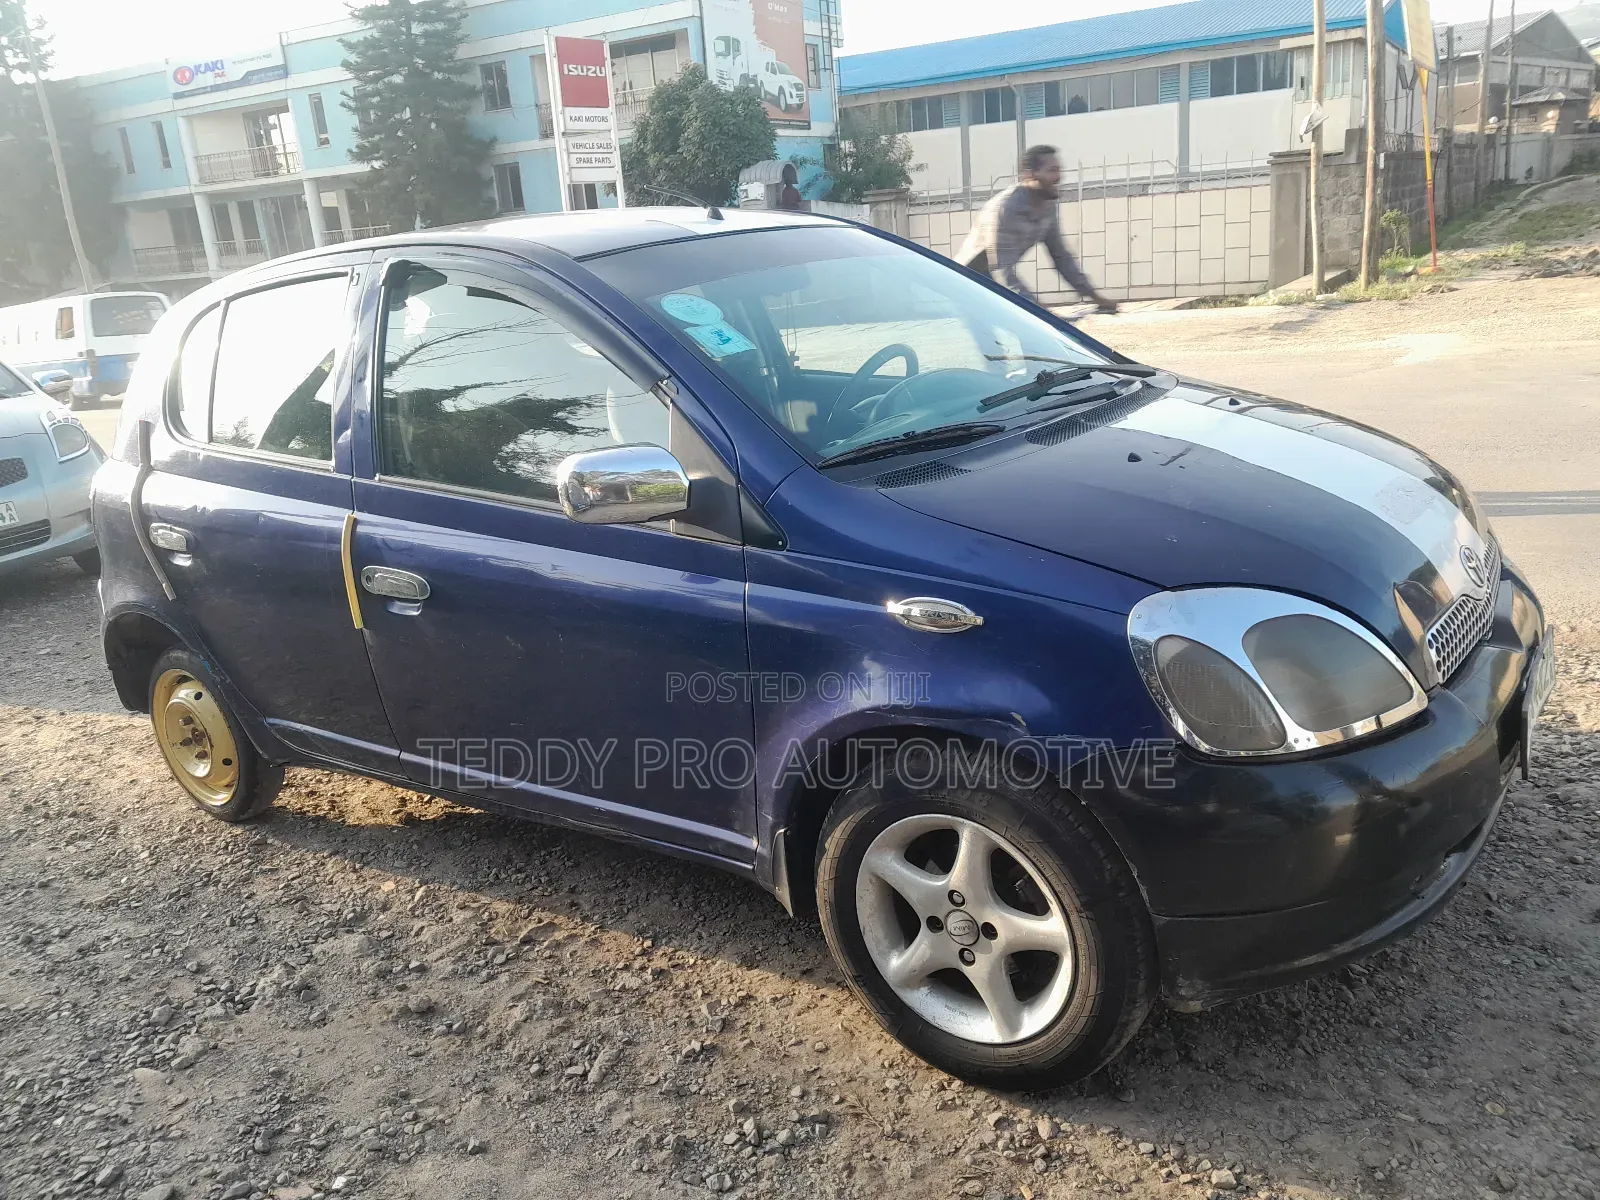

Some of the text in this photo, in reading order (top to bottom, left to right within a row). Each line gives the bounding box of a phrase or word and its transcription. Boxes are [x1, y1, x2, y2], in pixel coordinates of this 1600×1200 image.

[193, 59, 225, 76] KAKI
[563, 64, 605, 76] ISUZU
[569, 115, 609, 123] KAKI MOTORS
[571, 142, 613, 150] VEHICLE SALES
